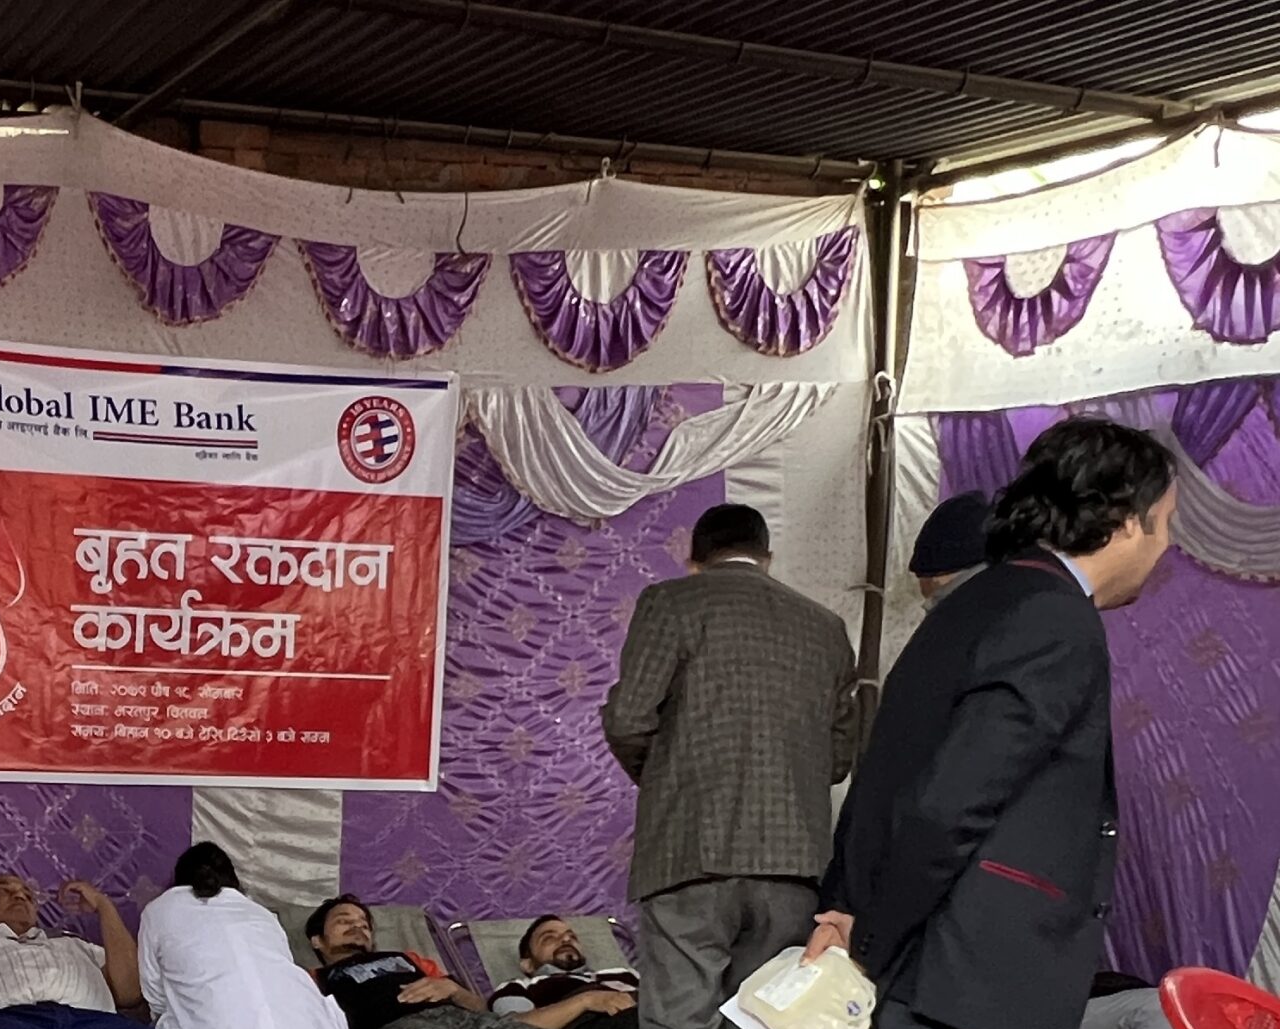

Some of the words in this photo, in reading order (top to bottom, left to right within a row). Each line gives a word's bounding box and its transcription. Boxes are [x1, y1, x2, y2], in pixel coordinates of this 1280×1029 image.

[88, 394, 160, 428] IME
[173, 401, 258, 432] Bank
[73, 528, 193, 594] बृहत
[208, 535, 395, 593] रक्तदान
[70, 589, 302, 660] कार्यक्रम
[153, 727, 172, 740] १०
[265, 730, 273, 744] ३
